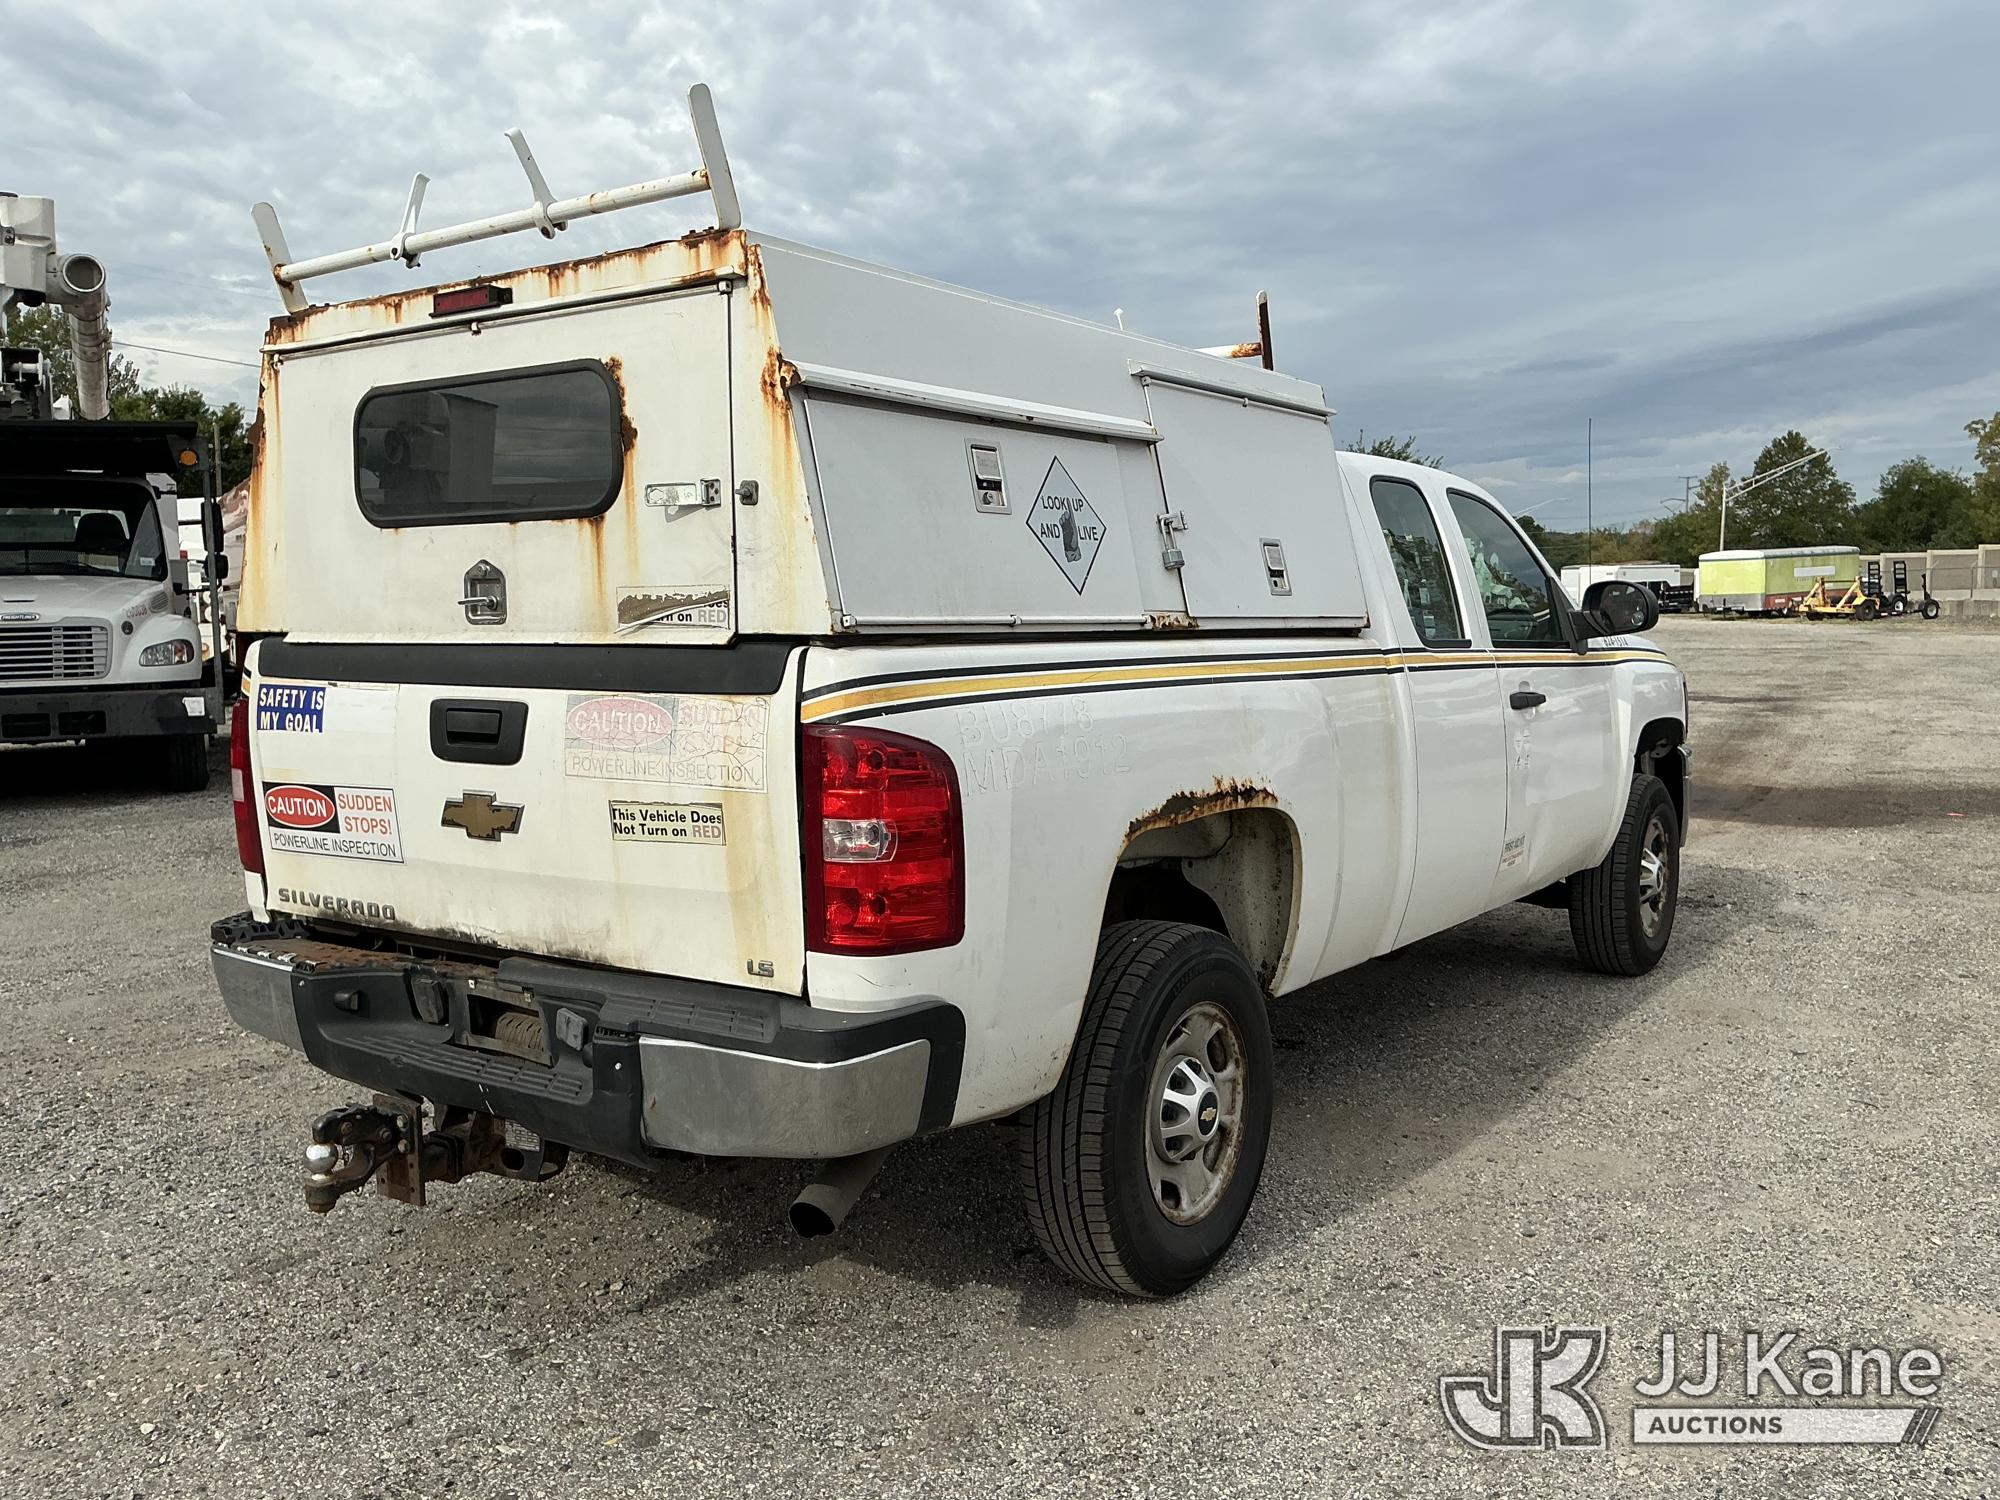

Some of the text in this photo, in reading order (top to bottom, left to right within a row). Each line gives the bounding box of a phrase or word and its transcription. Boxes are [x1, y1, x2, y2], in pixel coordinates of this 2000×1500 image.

[1041, 495, 1084, 512] LOOK UP
[1040, 523, 1099, 541] AND LIVE
[677, 613, 692, 622] on
[698, 609, 726, 622] RED
[259, 687, 324, 710] SAFETY IS
[260, 711, 320, 732] MY GOAL
[574, 709, 662, 734] CAUTION
[572, 755, 755, 783] POWERLINE INSPECTION
[267, 796, 327, 817] CAUTION
[338, 793, 392, 813] SUDDEN
[345, 816, 392, 836] STOPS!
[612, 808, 721, 824] This Vehicle Does
[613, 822, 721, 839] Not Turn on RED
[274, 833, 396, 857] POWERLINE INSPECTION
[278, 888, 396, 920] SILVERADO
[747, 959, 774, 978] LS
